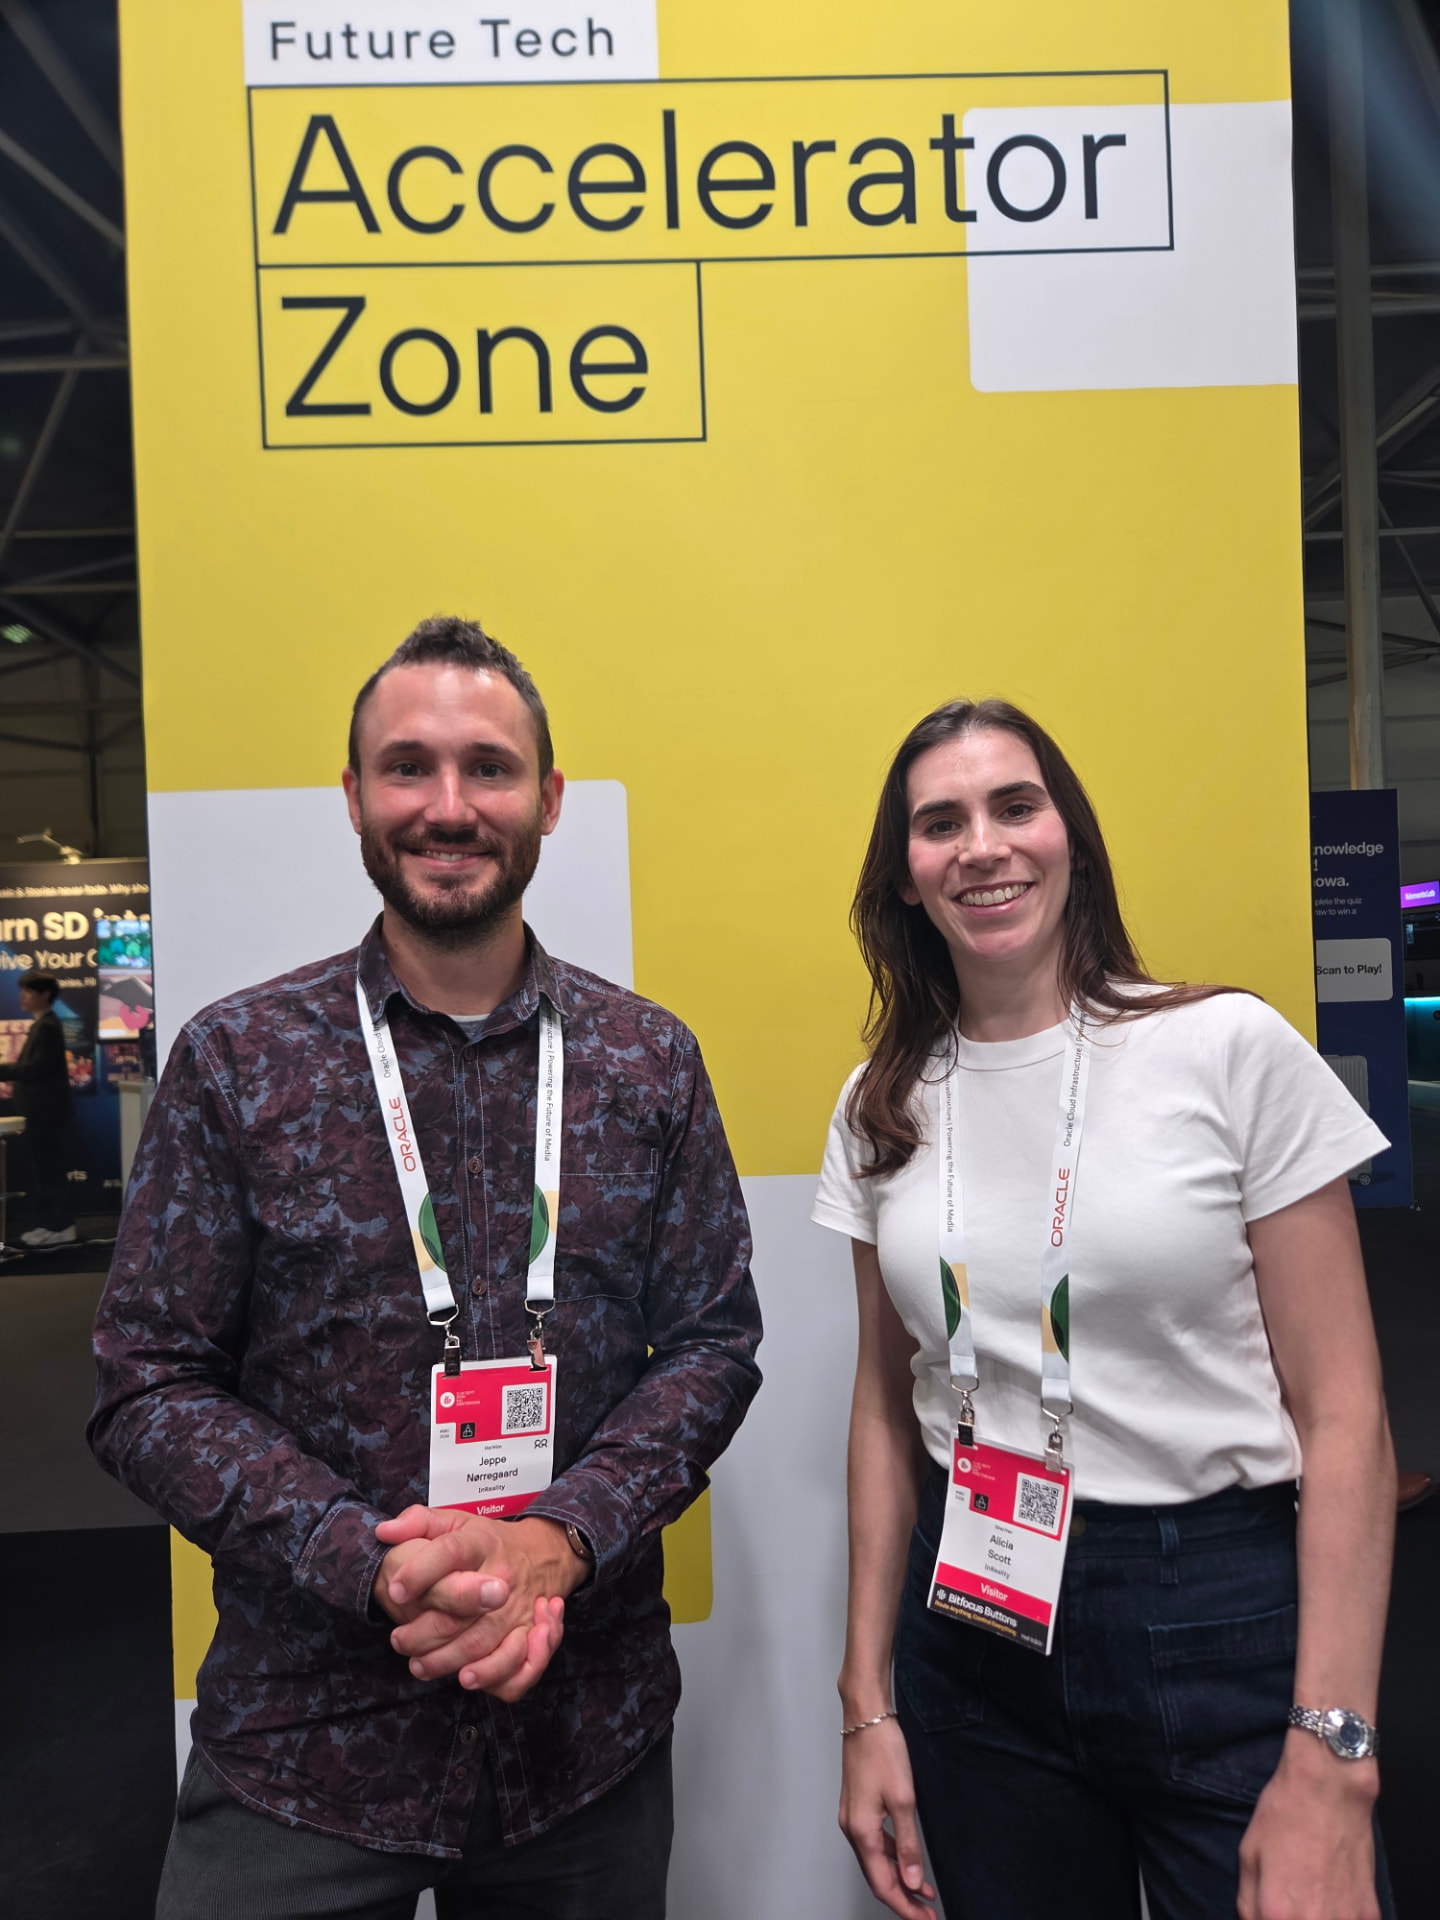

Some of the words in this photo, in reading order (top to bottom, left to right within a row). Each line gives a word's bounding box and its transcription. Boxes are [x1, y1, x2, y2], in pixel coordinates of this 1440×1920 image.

[272, 23, 454, 59] Future
[482, 19, 612, 56] Tech
[273, 110, 1126, 234] Accelerator
[282, 297, 648, 417] Zone
[1312, 841, 1384, 857] nowledge
[1314, 876, 1349, 888] owa.
[1328, 907, 1336, 916] to
[1337, 907, 1350, 916] win
[0, 917, 38, 942] rn
[43, 911, 89, 940] SD
[0, 950, 33, 970] ive
[34, 949, 84, 969] Your
[1316, 965, 1341, 975] Scan
[1344, 965, 1355, 975] to
[1357, 963, 1382, 976] Play!
[375, 1033, 386, 1053] Cloud
[380, 1053, 392, 1079] Oracle
[545, 1055, 555, 1088] Powering
[1069, 1047, 1083, 1098] Infrastructure
[546, 1102, 554, 1127] Future
[1067, 1099, 1077, 1122] Cloud
[389, 1096, 417, 1172] ORACLE
[545, 1128, 553, 1138] of
[1063, 1121, 1074, 1147] Oracle
[544, 1138, 552, 1162] Media
[1051, 1168, 1070, 1248] ORACLE
[479, 1456, 507, 1467] Jeppe
[466, 1467, 519, 1482] Nørregaard
[476, 1504, 505, 1516] Visitor
[989, 1534, 1014, 1551] Alicia
[987, 1549, 1011, 1566] Scott
[981, 1582, 1008, 1602] Visitor
[948, 1593, 984, 1614] Bitfocus
[984, 1605, 1018, 1628] Buttons
